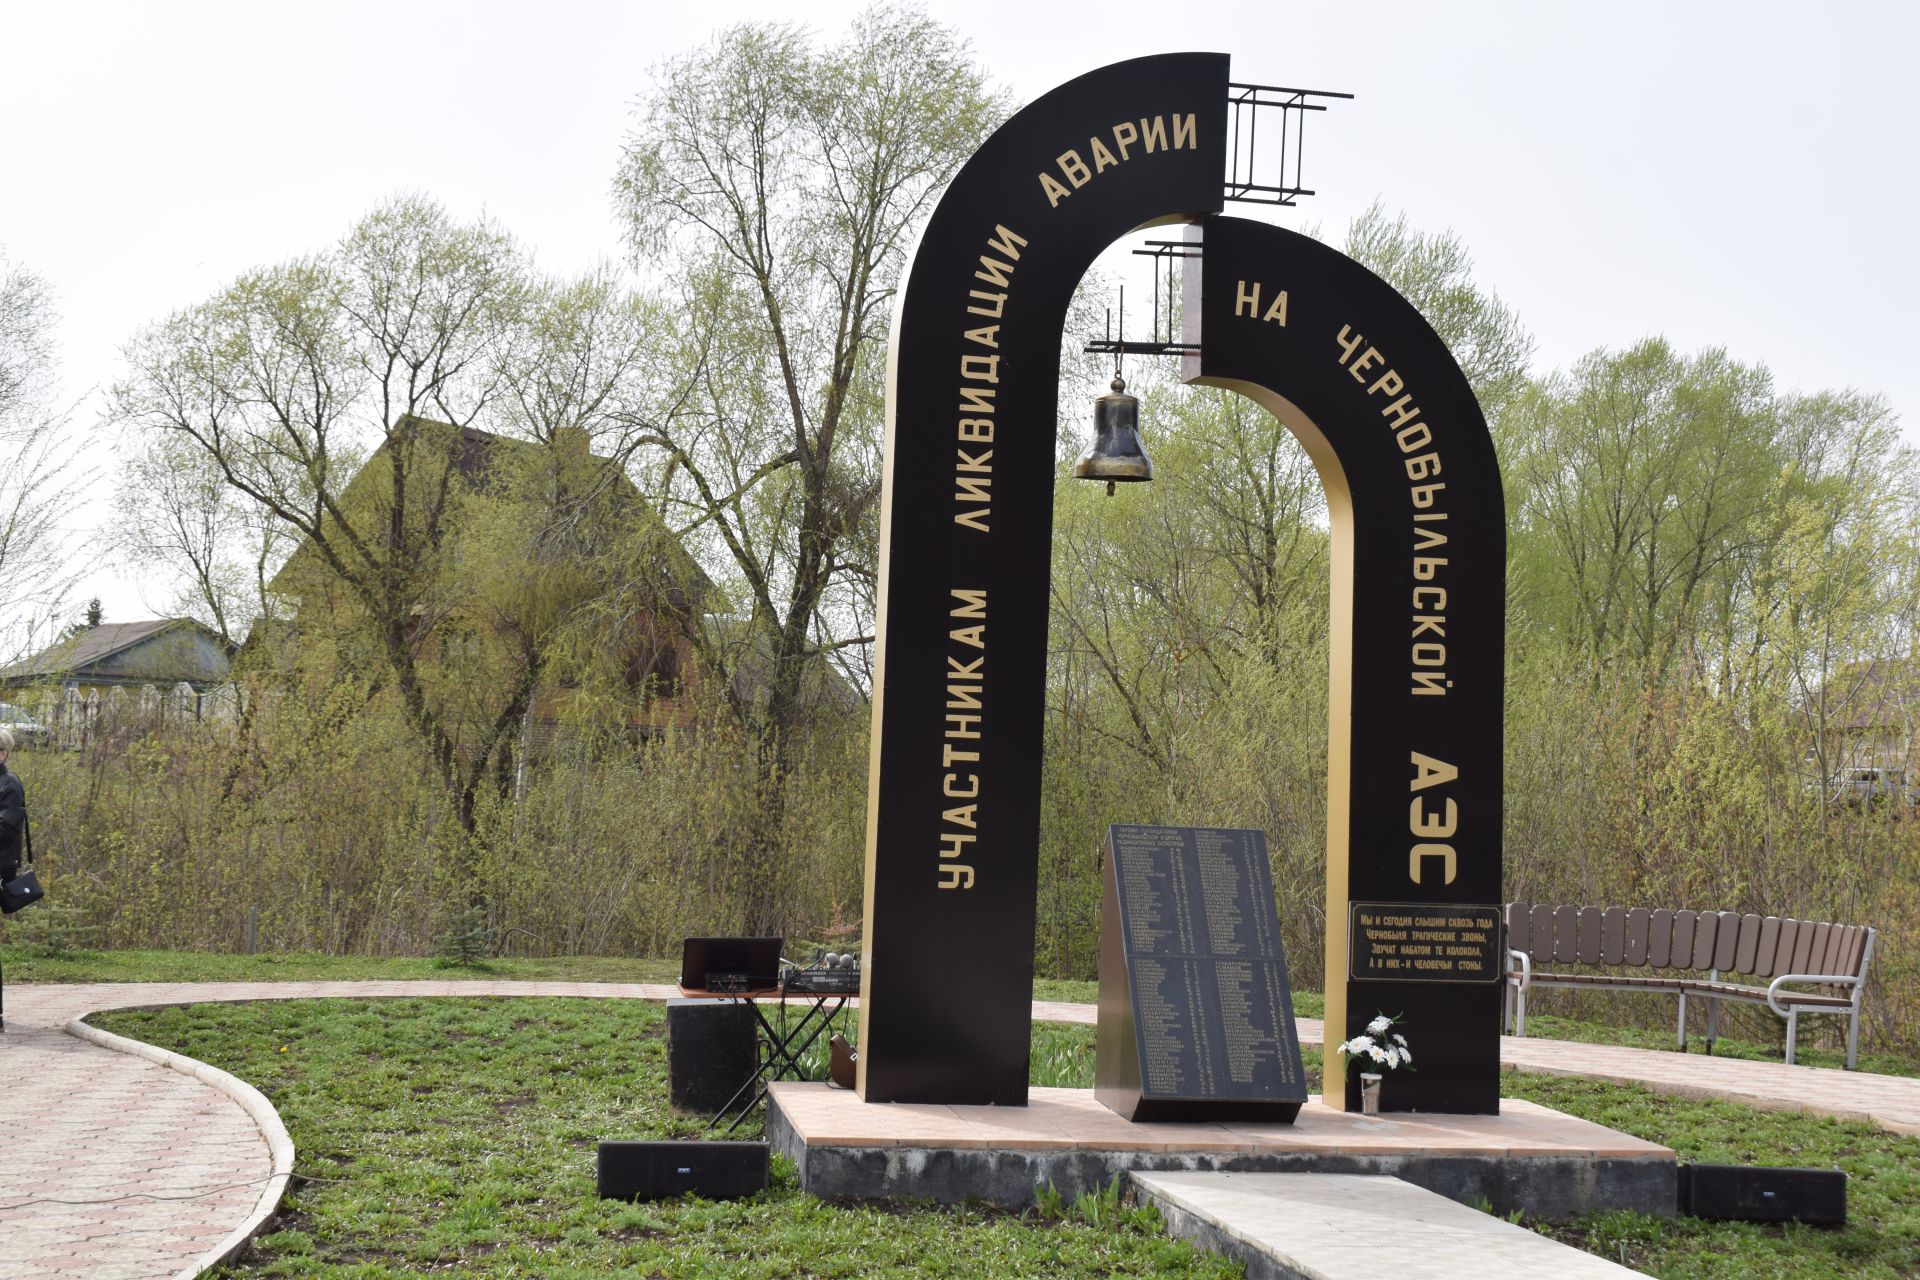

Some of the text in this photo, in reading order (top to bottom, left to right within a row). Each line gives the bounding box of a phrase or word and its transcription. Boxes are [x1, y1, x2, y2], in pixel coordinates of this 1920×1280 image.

[938, 113, 1197, 889] УЧАСТНИКАМ ЛИКВИДАЦИИ АВАРИИ
[1235, 280, 1458, 885] НА ЧЕРНОБЫЛЬСКОЙ АЭС
[1375, 916, 1380, 926] И
[1383, 916, 1412, 927] СЕГОДНЯ
[1414, 917, 1446, 927] СЛЫШИМ
[1448, 918, 1474, 928] СКВОЗЬ
[1476, 918, 1493, 930] ГОДА
[1412, 931, 1456, 942] ТРАГИЧЕСКИЕ
[1371, 943, 1396, 954] ЗВУЧАТ
[1400, 945, 1431, 955] НАБАТОМ
[1435, 946, 1443, 955] ТЕ
[1369, 957, 1375, 968] А
[1377, 959, 1383, 968] В
[1414, 960, 1452, 970] ЧЕЛОВЕЧЬИ
[1458, 961, 1483, 971] СТОНЫ.
